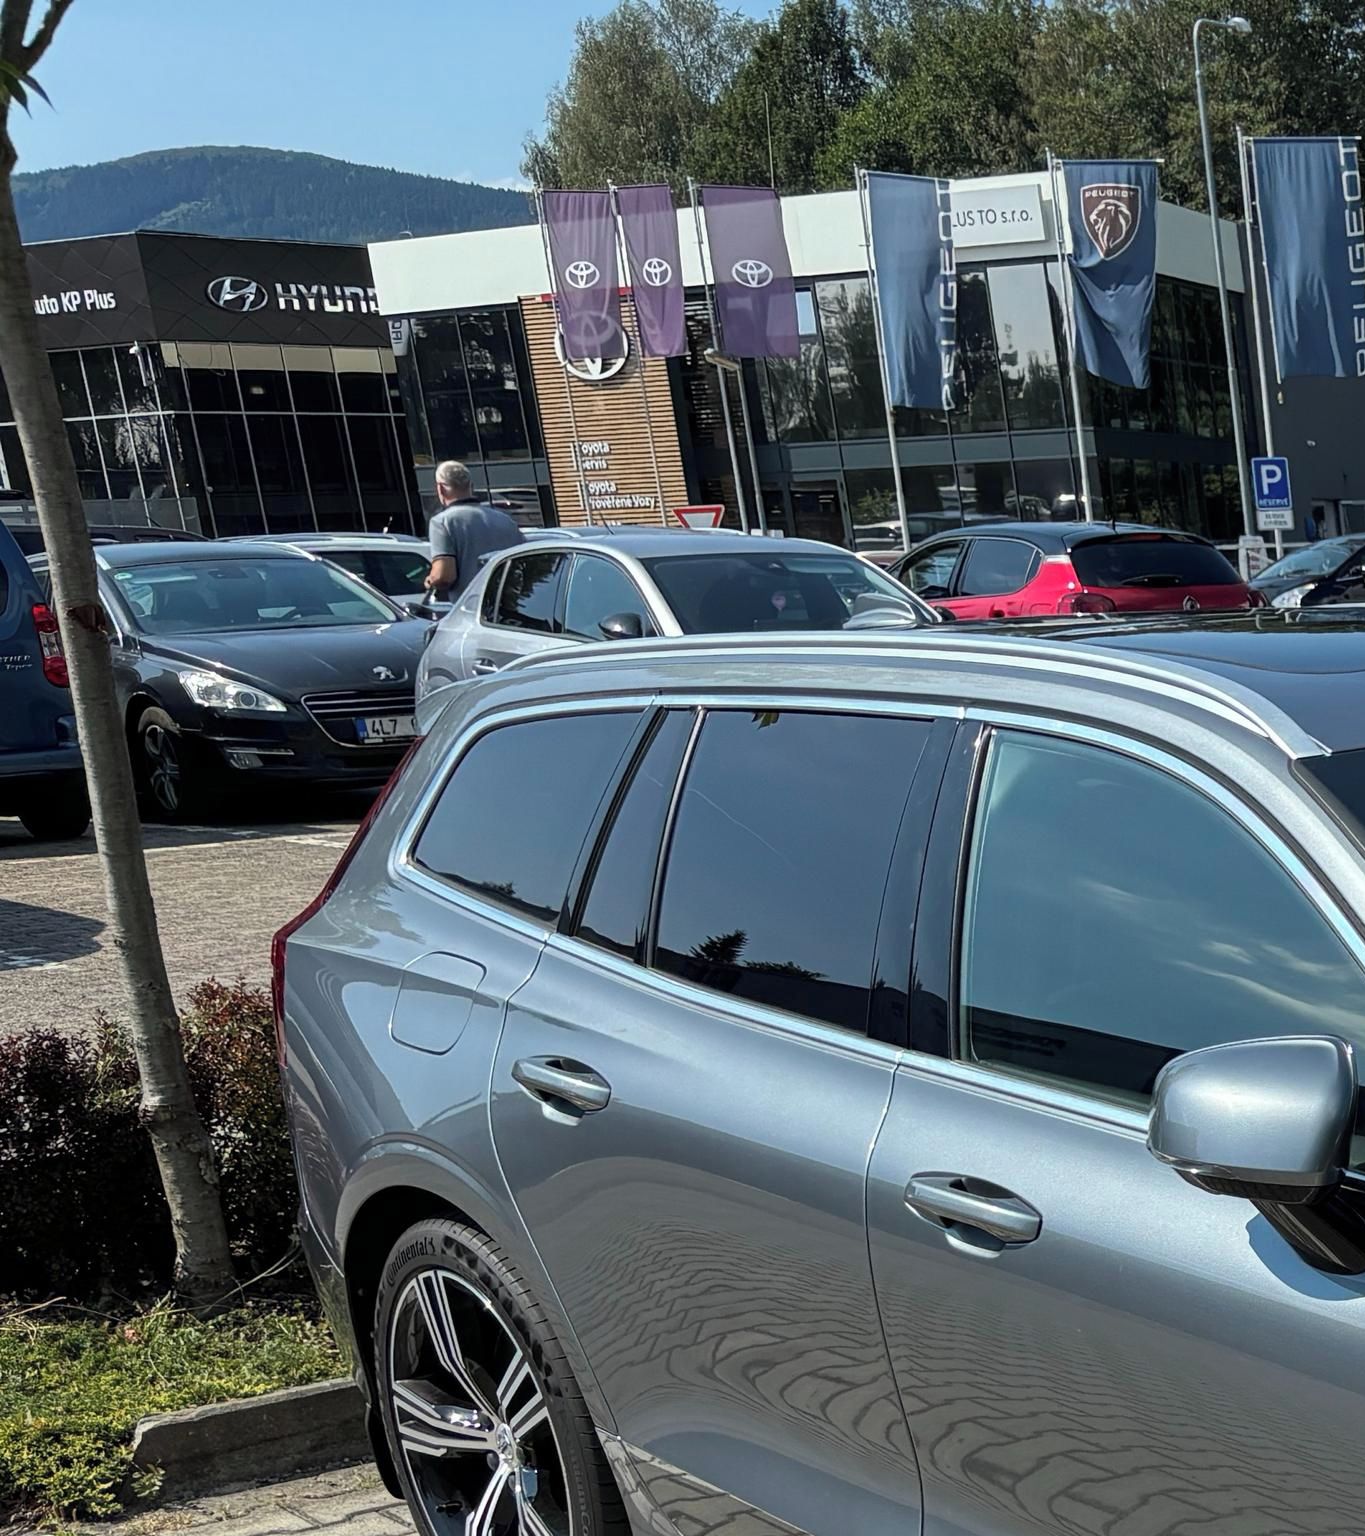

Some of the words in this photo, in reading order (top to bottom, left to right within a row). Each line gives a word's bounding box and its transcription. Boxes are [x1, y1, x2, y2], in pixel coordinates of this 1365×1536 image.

[952, 210, 975, 228] US
[977, 208, 997, 225] TO
[1001, 209, 1033, 223] s.r.o.
[34, 294, 59, 315] uto
[60, 291, 80, 313] KP
[83, 289, 116, 311] Plus
[1260, 464, 1282, 496] P
[371, 718, 397, 736] 4L7
